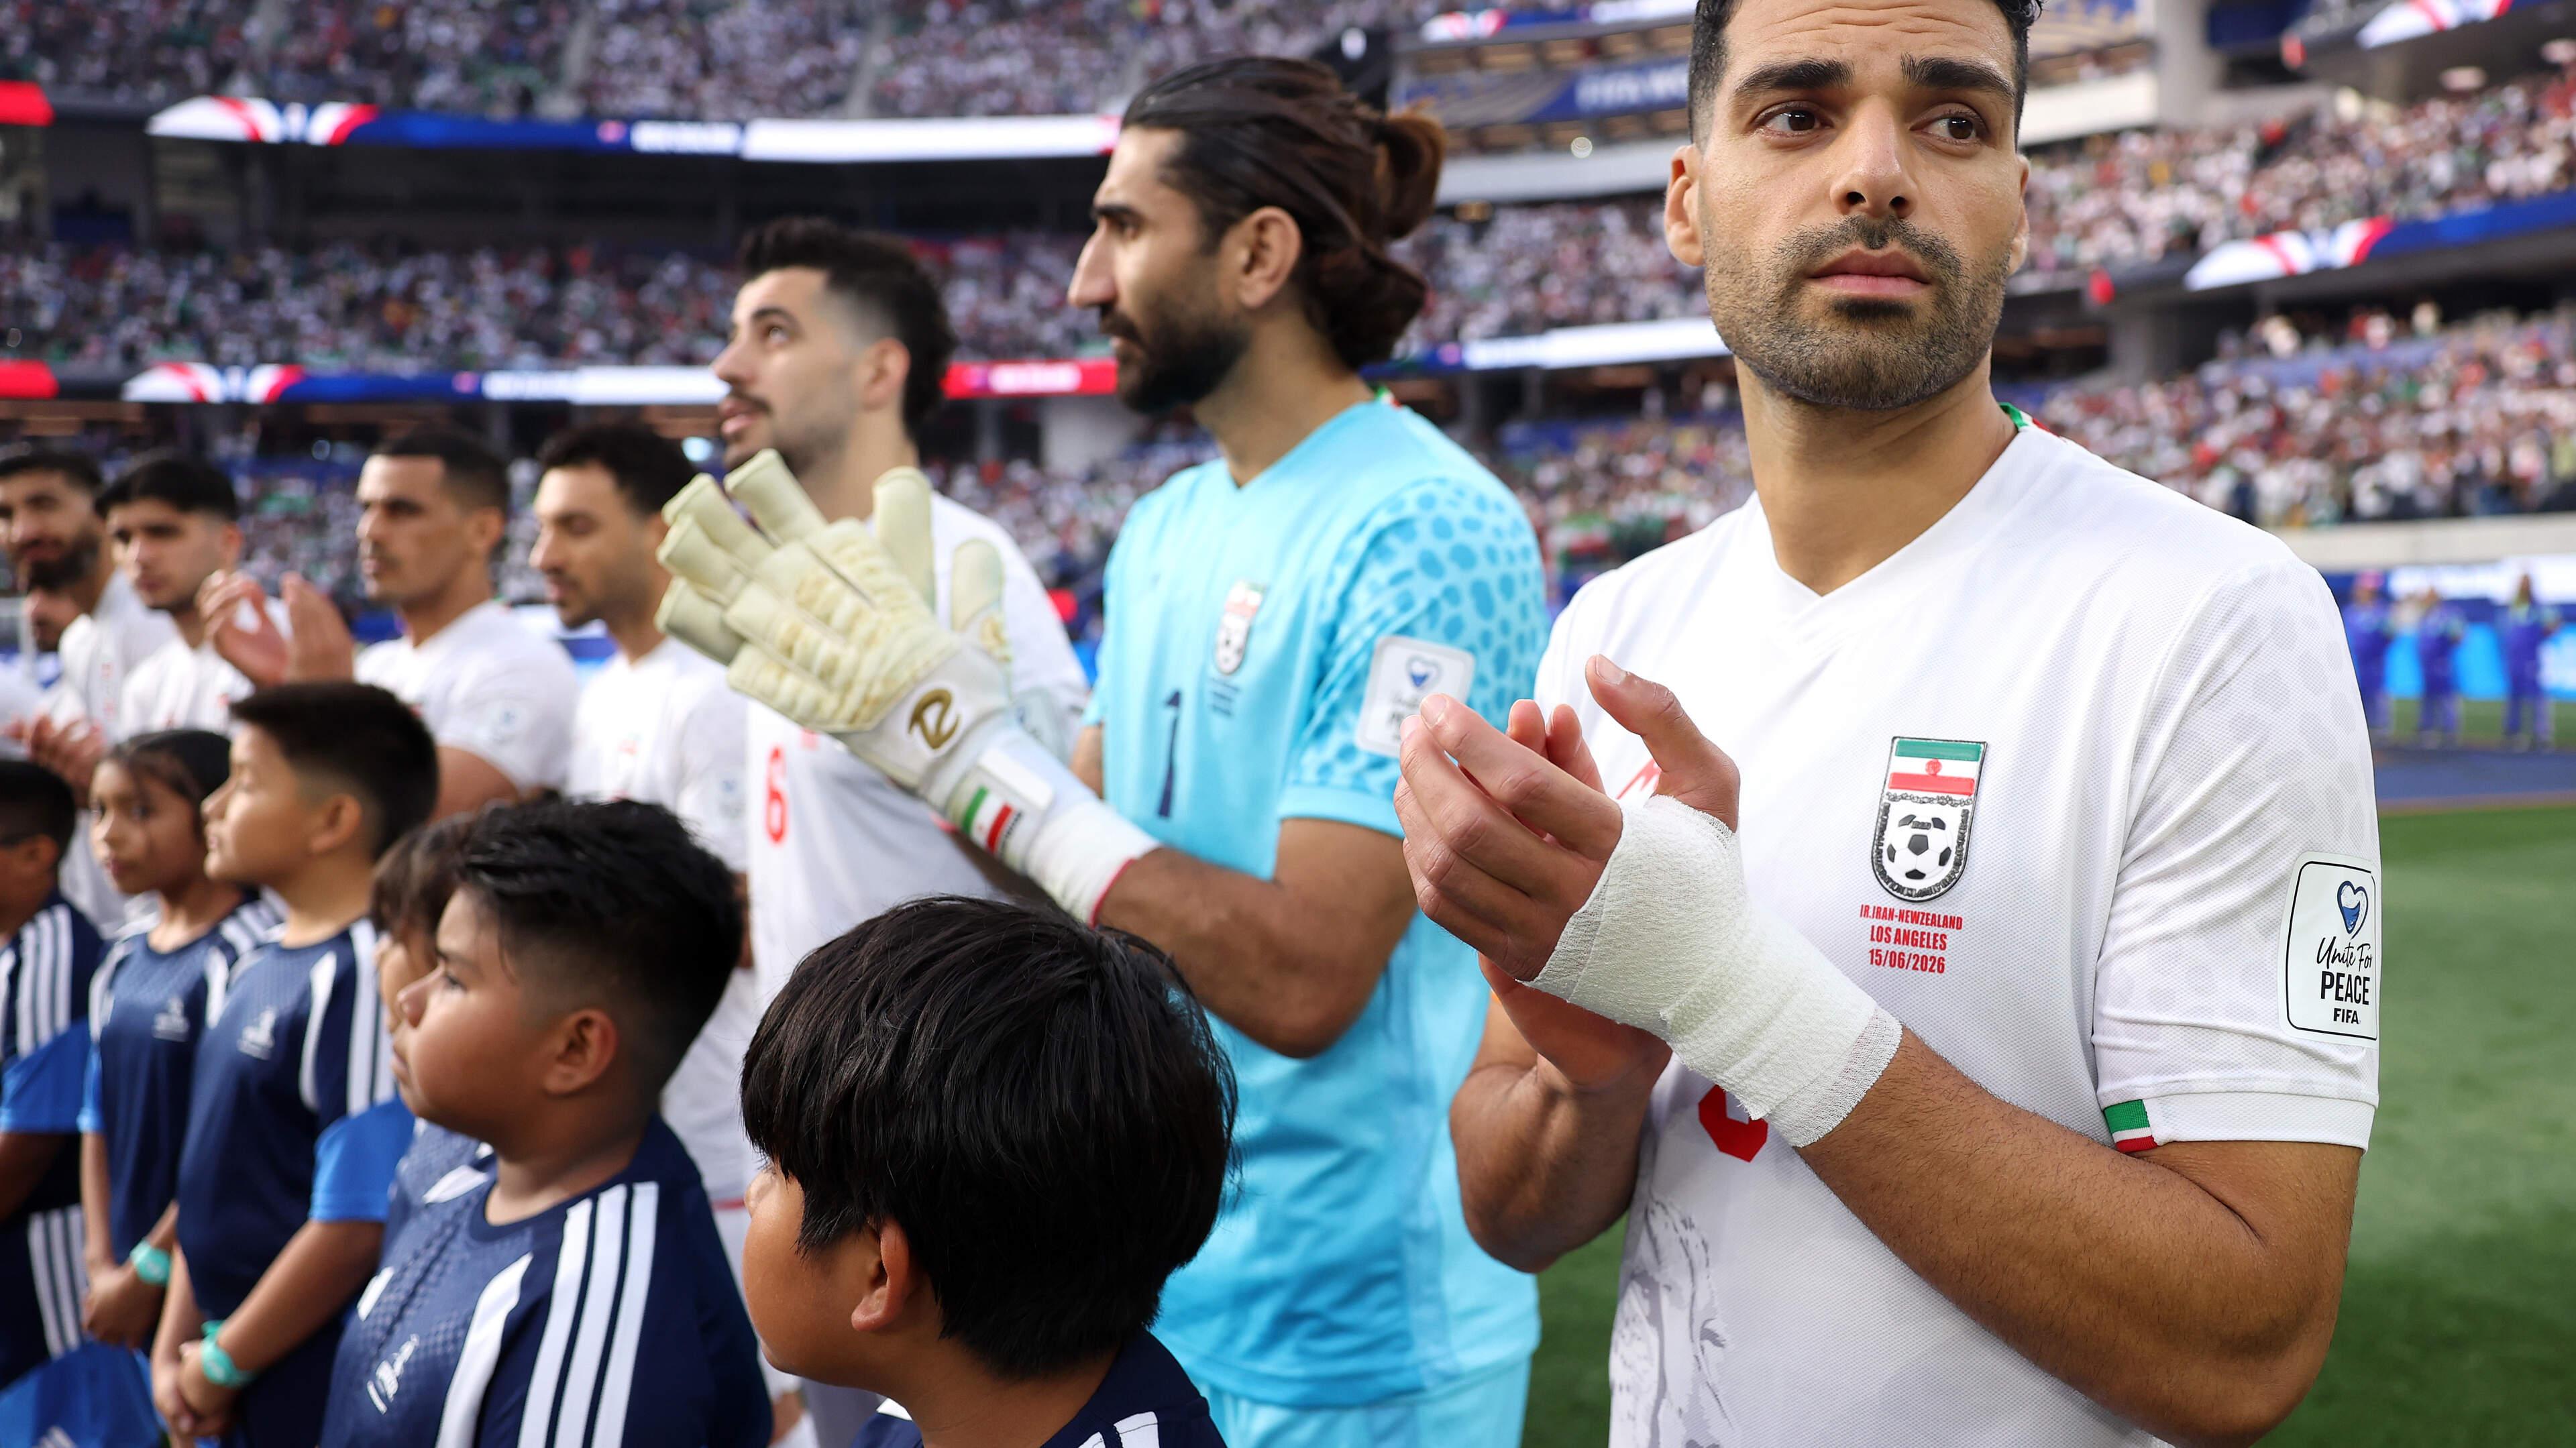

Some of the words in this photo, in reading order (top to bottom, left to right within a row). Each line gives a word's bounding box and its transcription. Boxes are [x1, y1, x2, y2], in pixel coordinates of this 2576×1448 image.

[765, 746, 788, 845] 6
[1860, 904, 1963, 930] IR.IRAN-NEWZEALAND
[1870, 925, 1892, 944] LOS
[1893, 928, 1947, 951] ANGELES
[1869, 948, 1946, 974] 15/06/2026
[2316, 936, 2356, 970] Unite
[2320, 970, 2371, 1005] PEACE
[2333, 1007, 2359, 1025] FIFA
